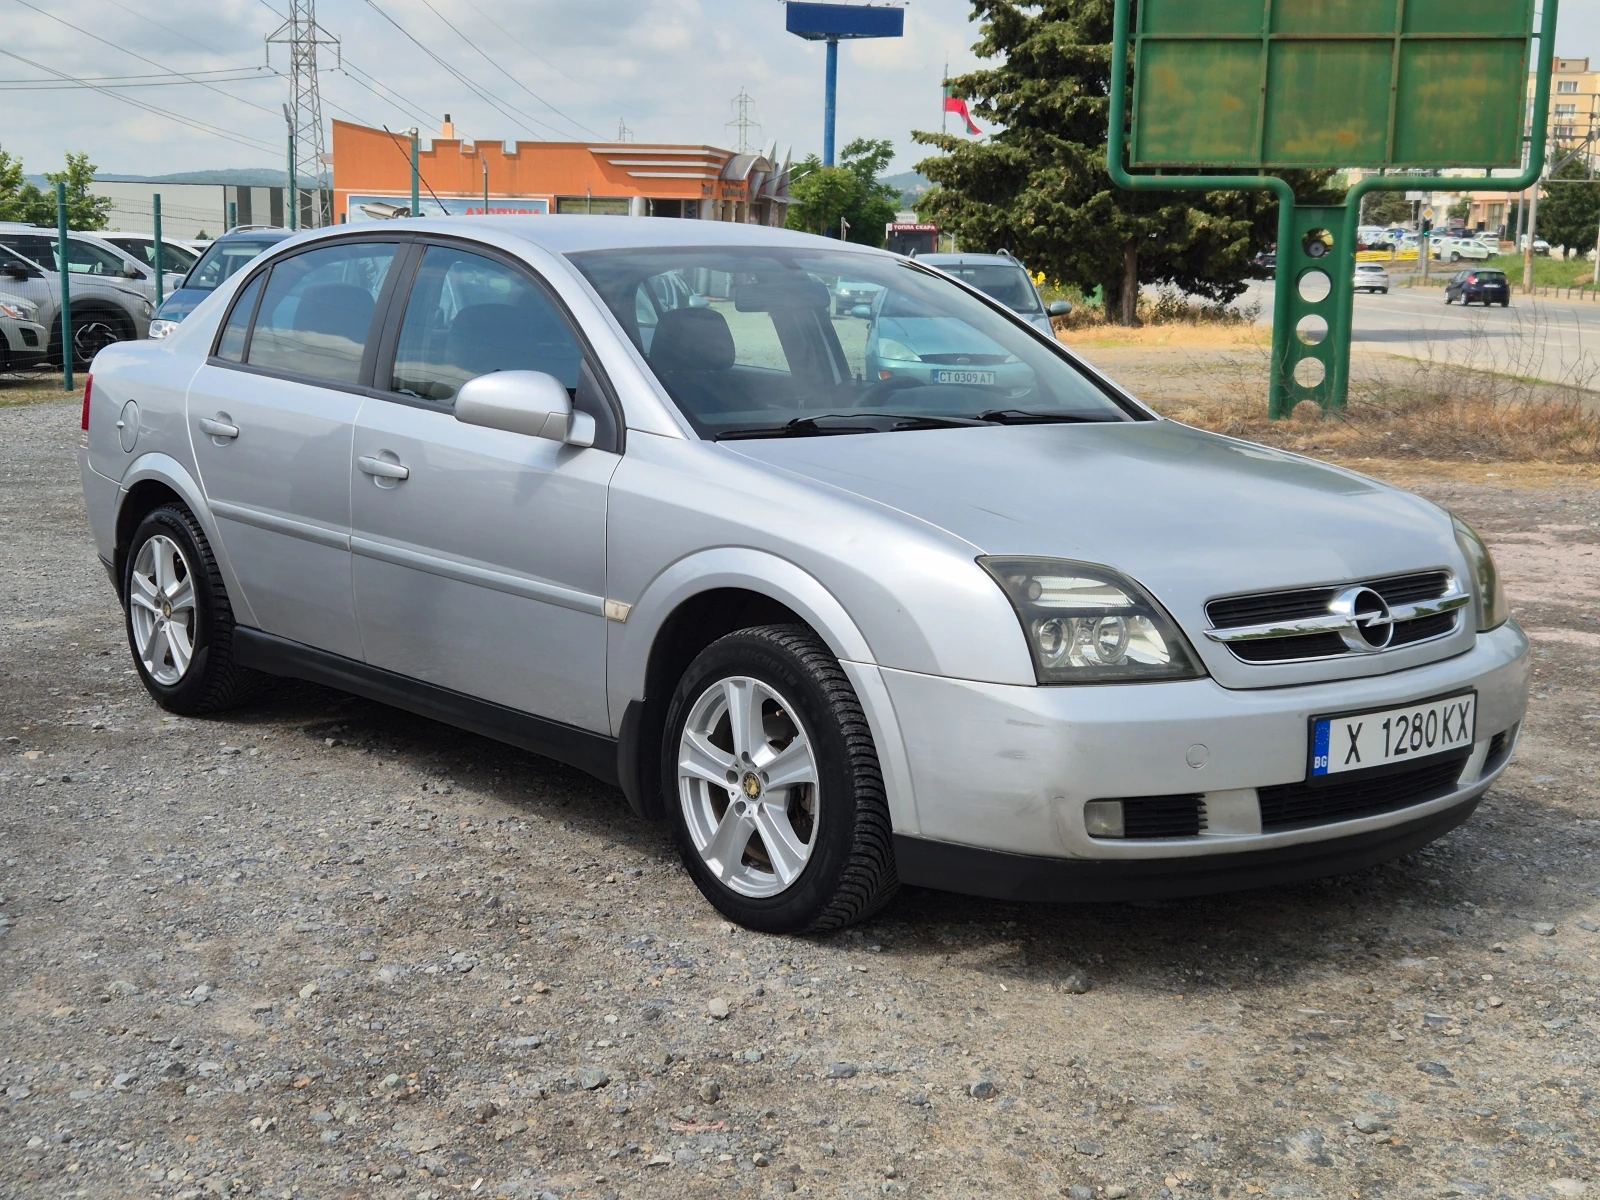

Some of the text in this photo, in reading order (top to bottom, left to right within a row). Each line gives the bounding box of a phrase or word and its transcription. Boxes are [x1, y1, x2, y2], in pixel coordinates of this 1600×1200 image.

[940, 372, 992, 383] CT 0309 AT
[739, 648, 798, 687] MICHELIN
[1345, 722, 1363, 764] X
[1313, 755, 1328, 769] BG
